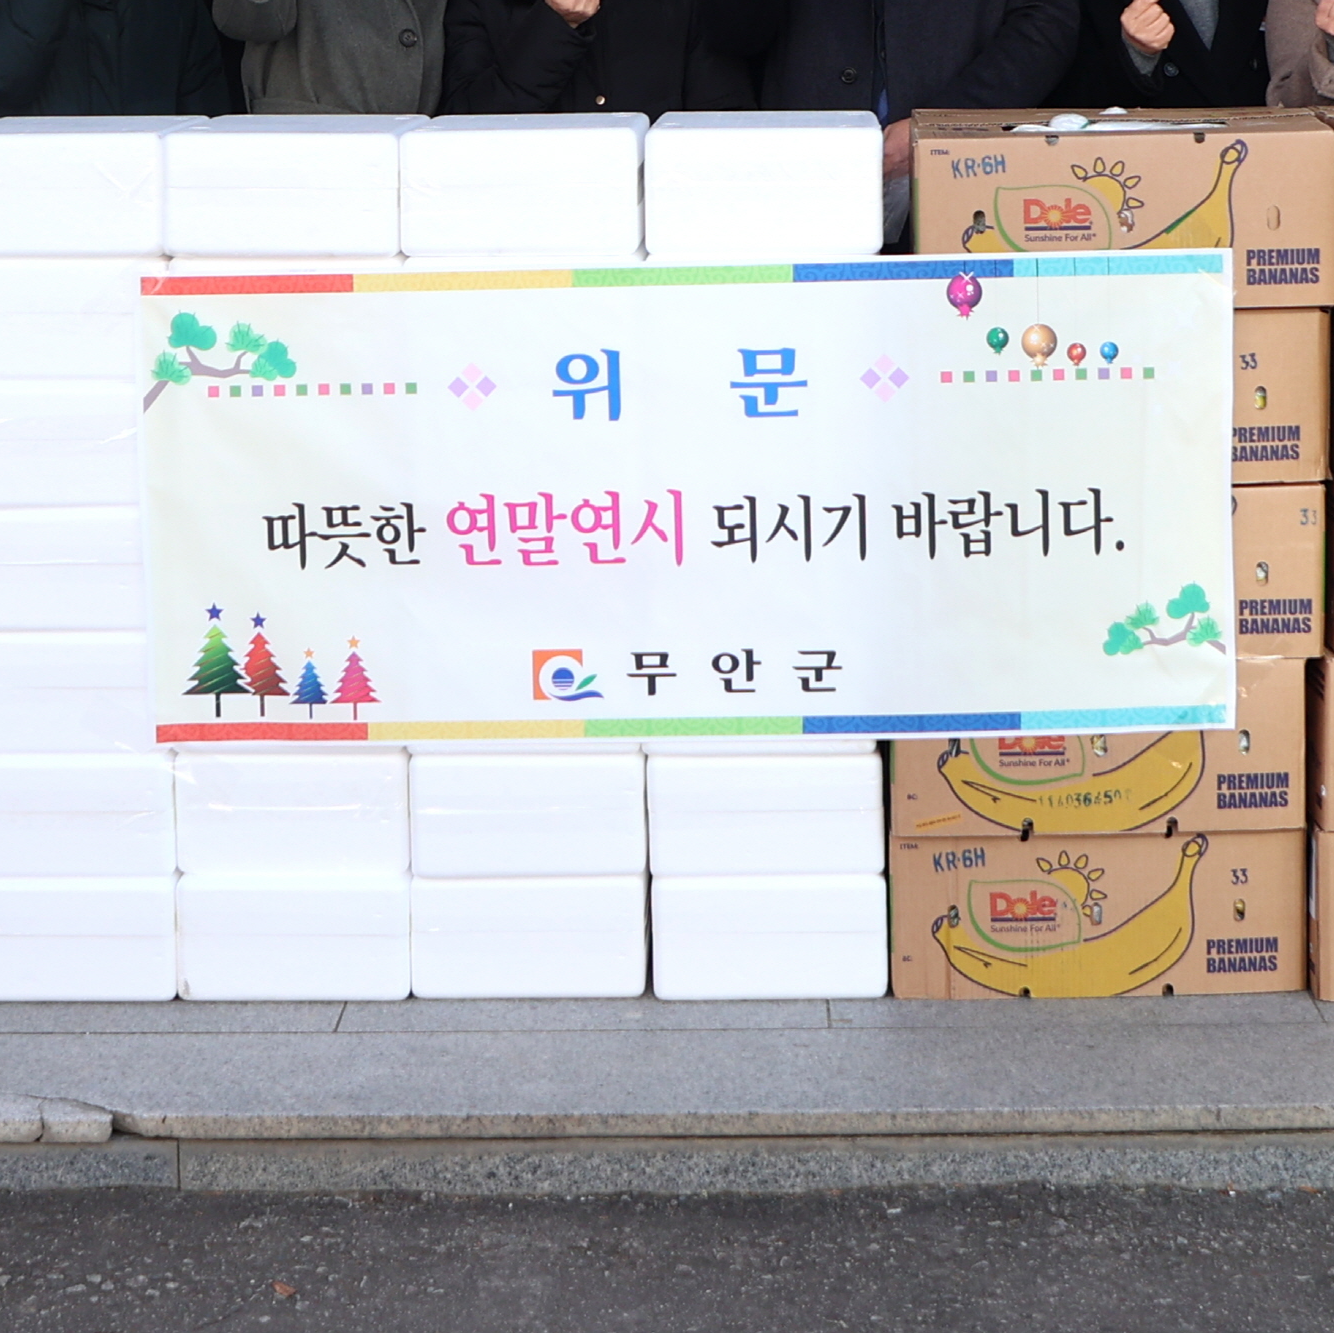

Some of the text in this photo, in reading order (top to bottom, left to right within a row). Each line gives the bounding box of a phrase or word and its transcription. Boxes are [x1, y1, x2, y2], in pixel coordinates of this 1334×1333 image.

[1025, 199, 1091, 226] Dole
[1023, 232, 1062, 242] Sunshine
[1063, 233, 1078, 241] For
[1247, 248, 1320, 267] PREMIUM
[1246, 266, 1319, 287] BANANAS
[1239, 353, 1257, 370] 33
[553, 348, 807, 420] 위 문
[263, 488, 1124, 569] 따뜻한 연말연시 되시기 바랍니다.
[1239, 599, 1312, 615] PREMIUM
[1239, 617, 1312, 634] BANANAS
[1217, 772, 1289, 791] PREMIUM
[1216, 790, 1288, 809] BANANAS
[1231, 868, 1249, 885] 33
[991, 892, 1056, 917] Dole
[990, 924, 1027, 933] Sunshine
[1029, 924, 1043, 932] For
[1207, 937, 1278, 955] PREMIUM
[1206, 955, 1277, 974] BANANAS
